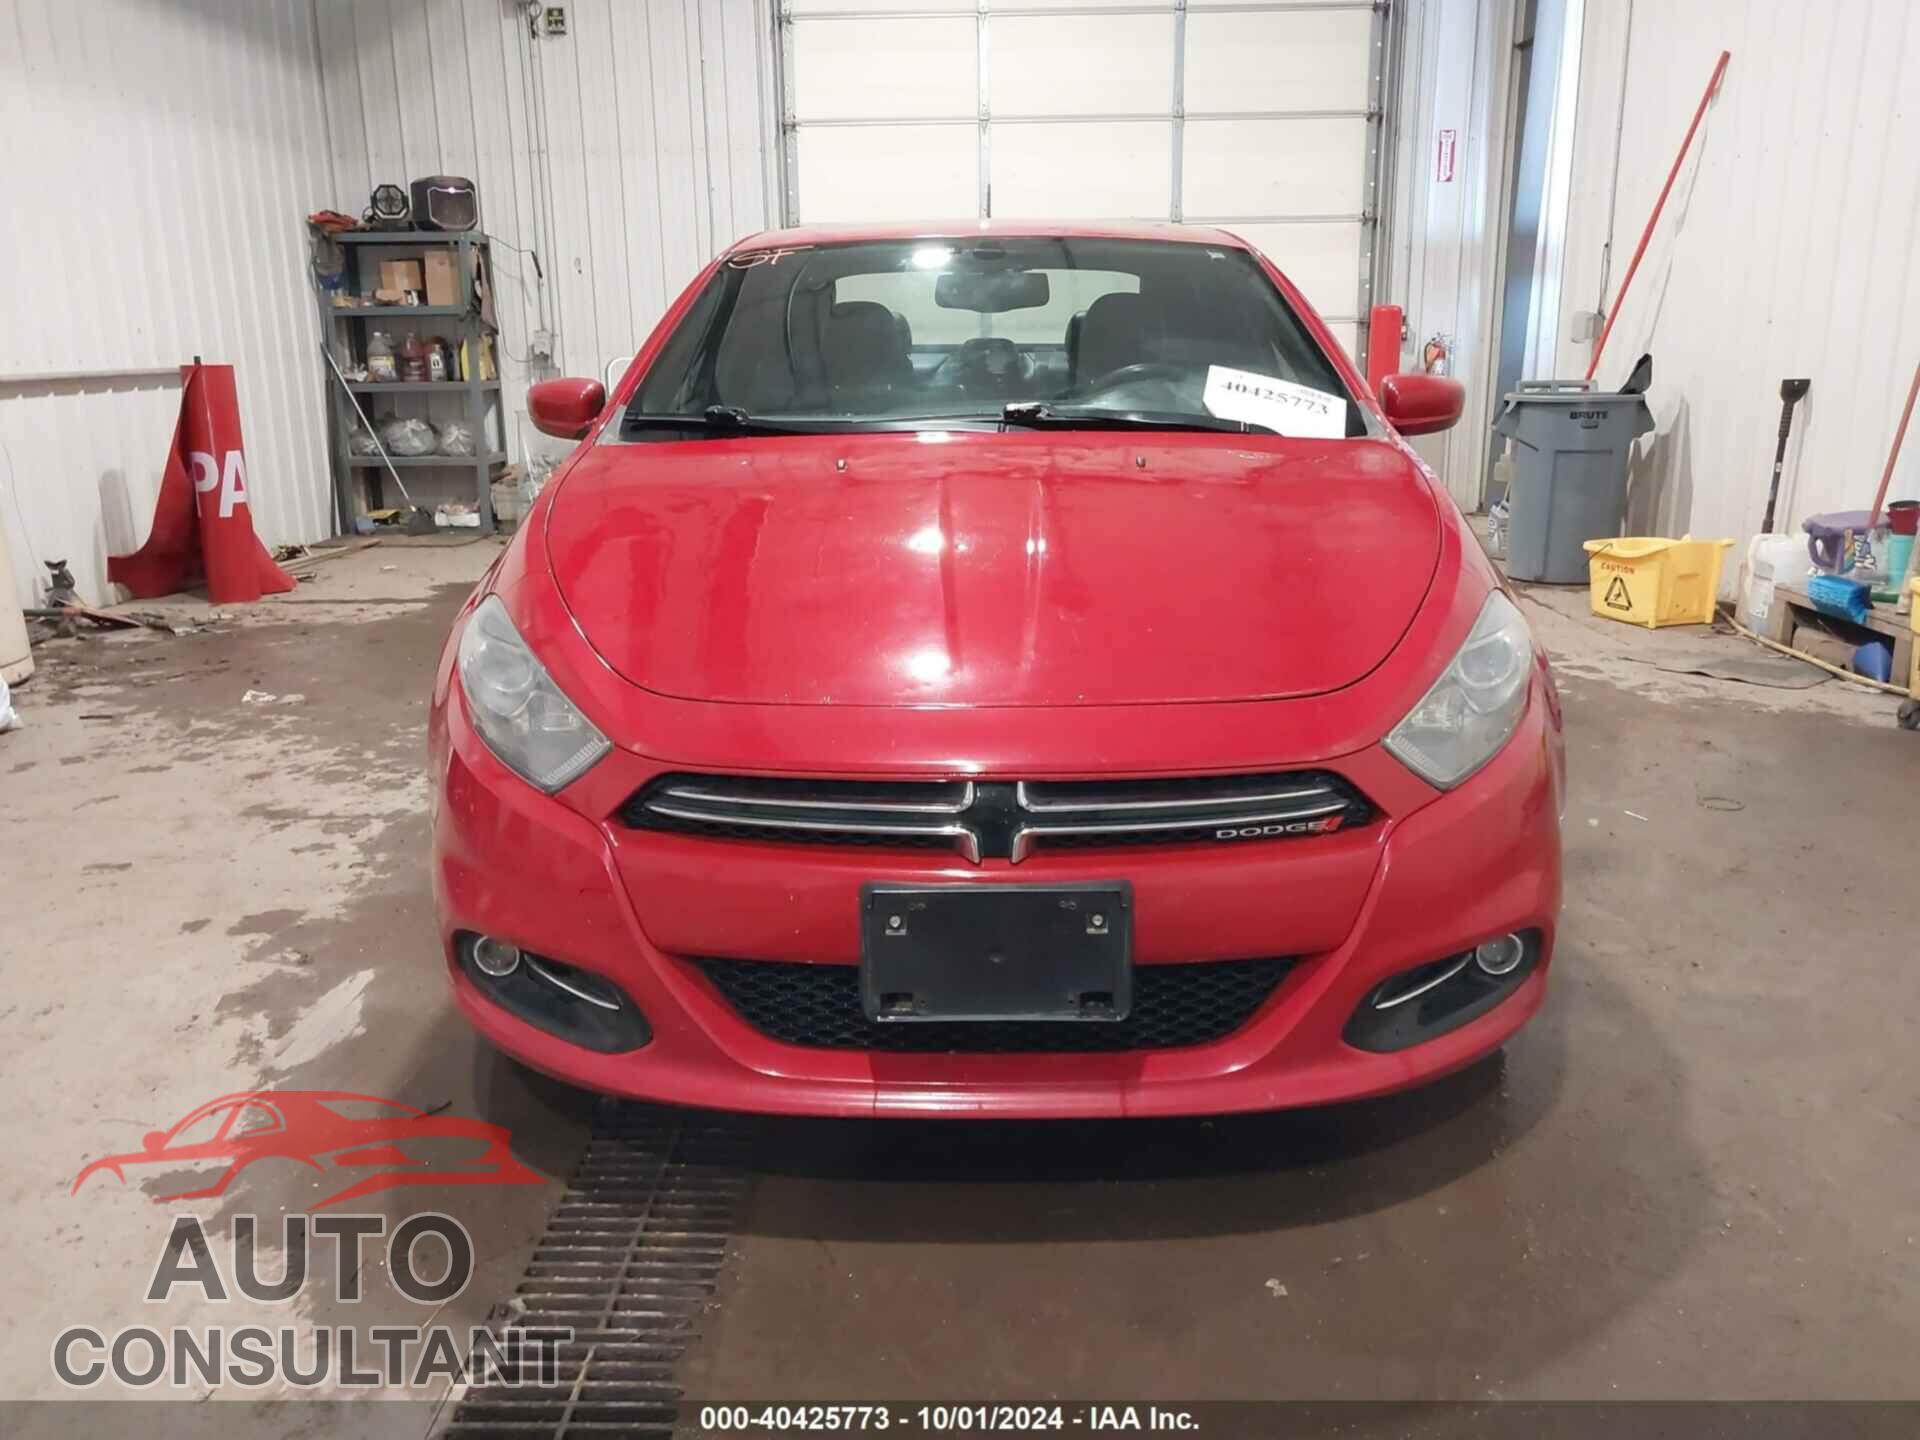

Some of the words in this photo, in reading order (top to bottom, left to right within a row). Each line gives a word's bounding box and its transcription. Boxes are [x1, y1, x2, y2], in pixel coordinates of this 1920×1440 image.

[1219, 381, 1329, 415] 40425773
[1569, 410, 1609, 420] BRUTE
[1600, 561, 1635, 575] CAUTION
[1215, 821, 1326, 839] DODGE
